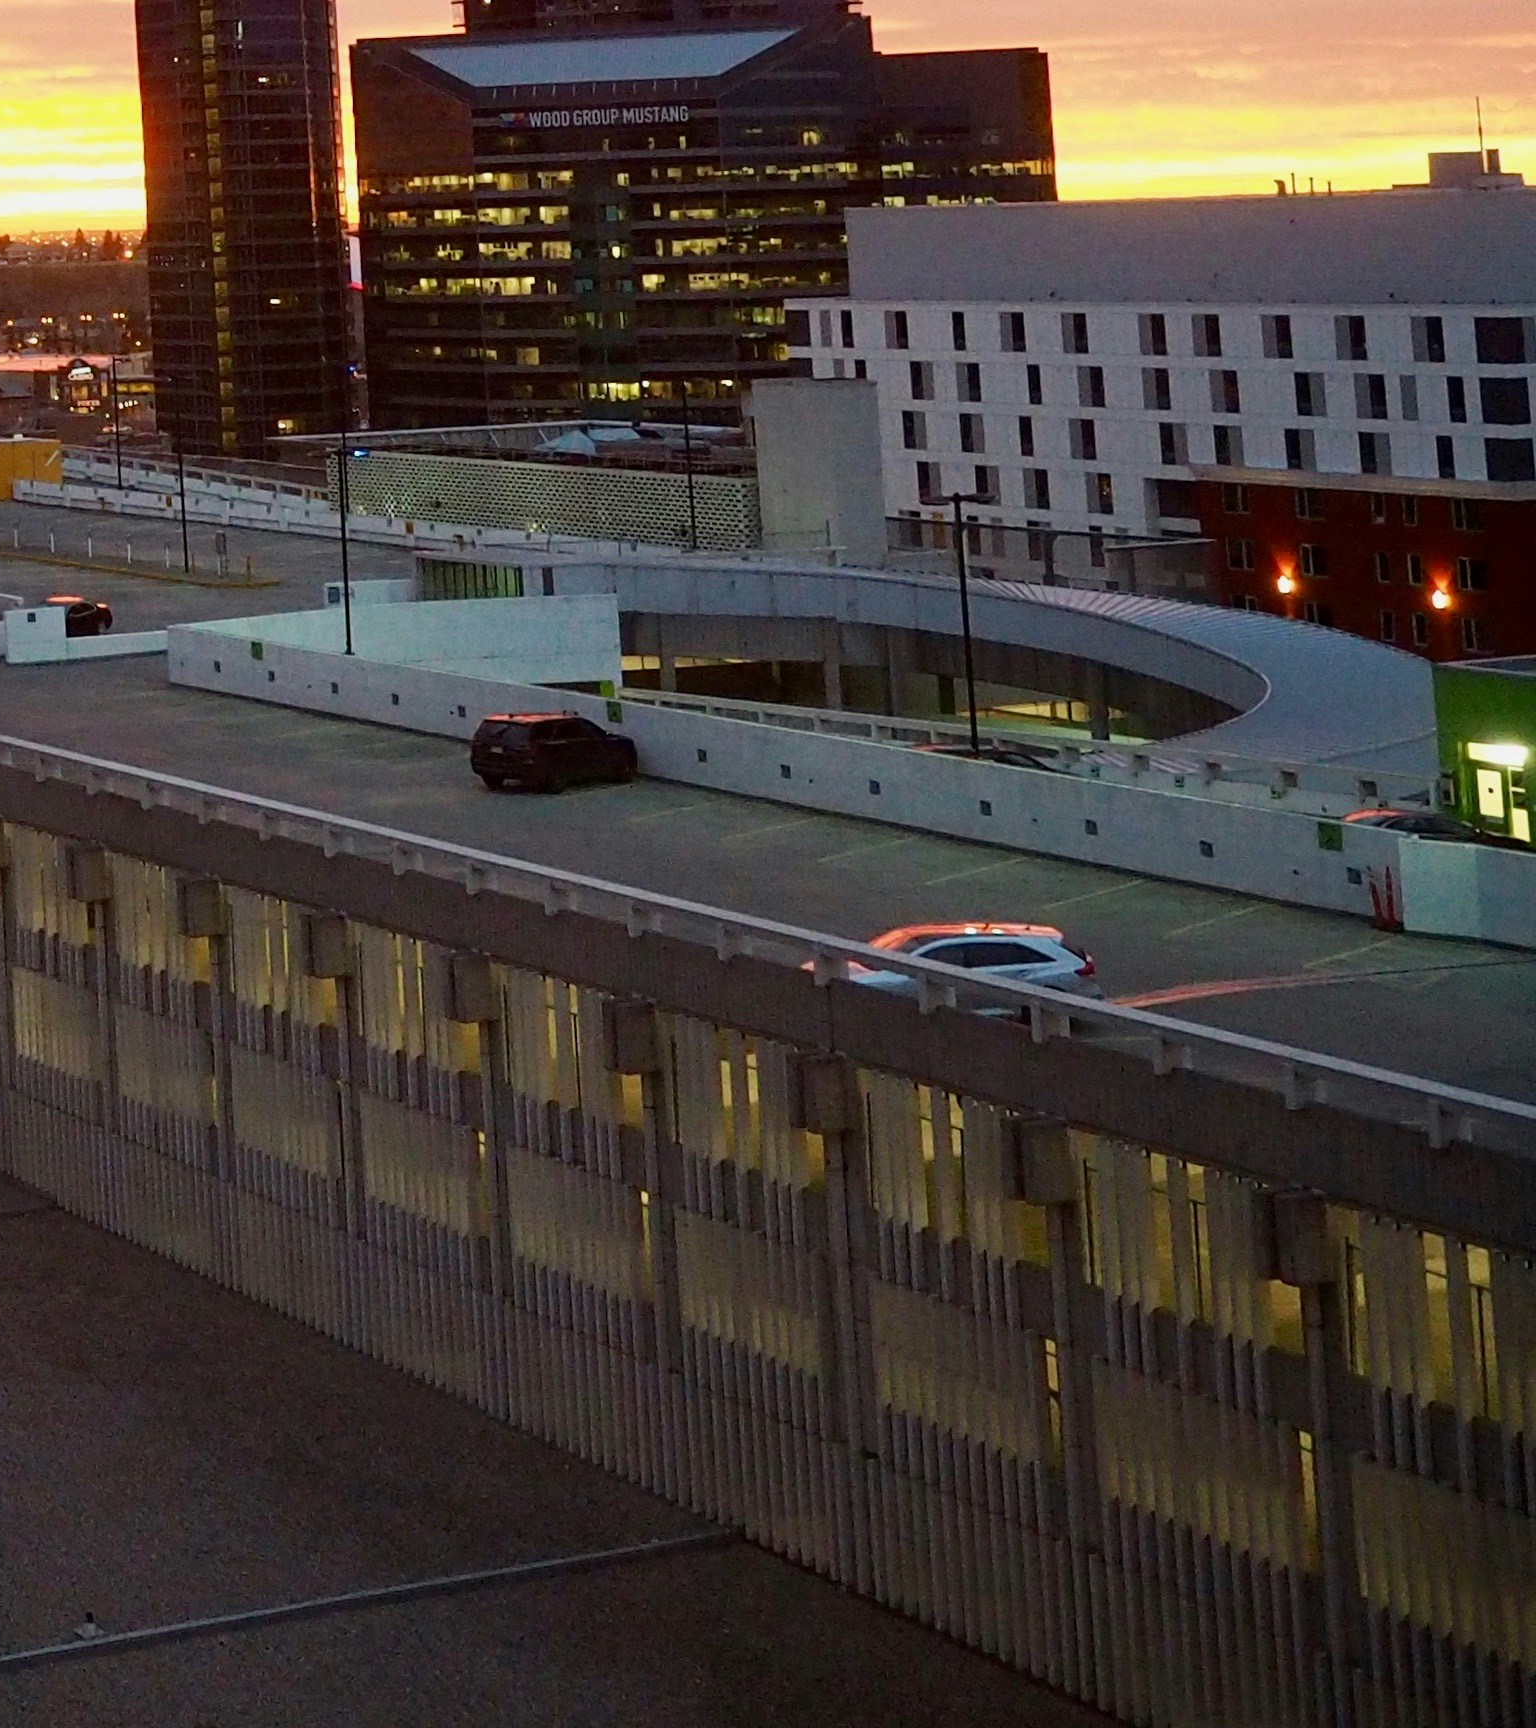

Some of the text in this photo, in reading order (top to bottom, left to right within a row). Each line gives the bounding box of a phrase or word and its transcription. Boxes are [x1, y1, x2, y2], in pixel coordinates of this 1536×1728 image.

[529, 106, 689, 127] WOOD GROUP MUSTANG
